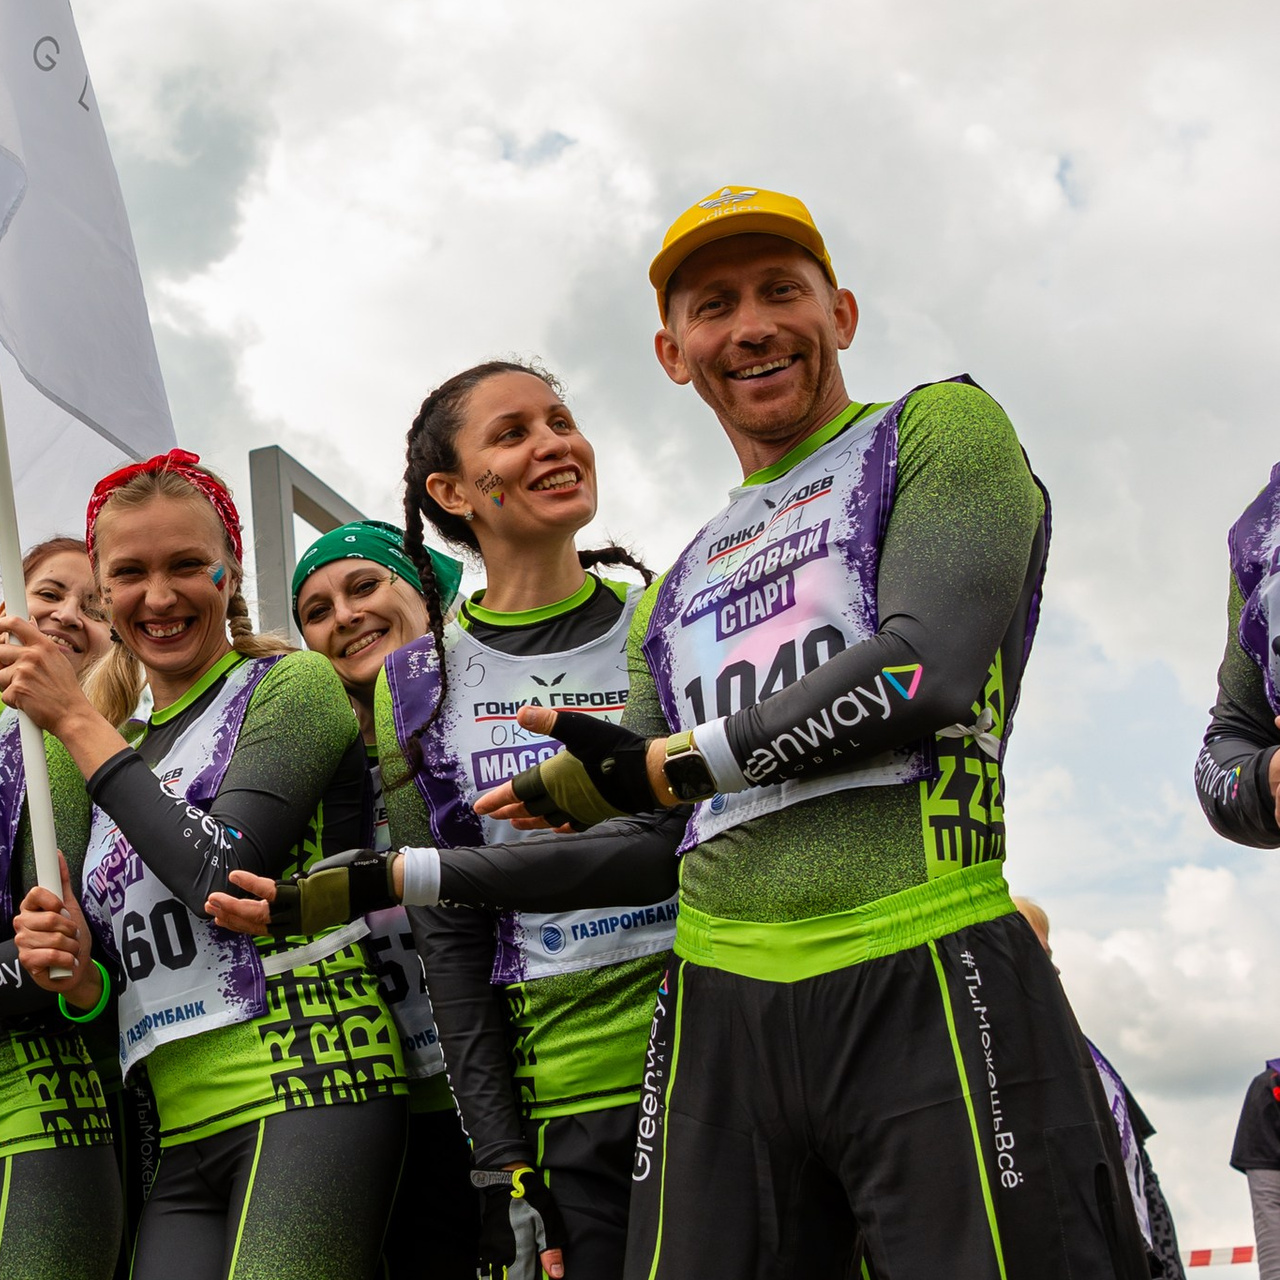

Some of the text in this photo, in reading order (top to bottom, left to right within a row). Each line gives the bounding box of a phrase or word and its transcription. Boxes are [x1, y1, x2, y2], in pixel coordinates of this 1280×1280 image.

[708, 524, 766, 558] ГОНКА
[720, 578, 791, 636] СТАРТ
[464, 651, 486, 688] 5
[632, 995, 667, 1182] Greenway
